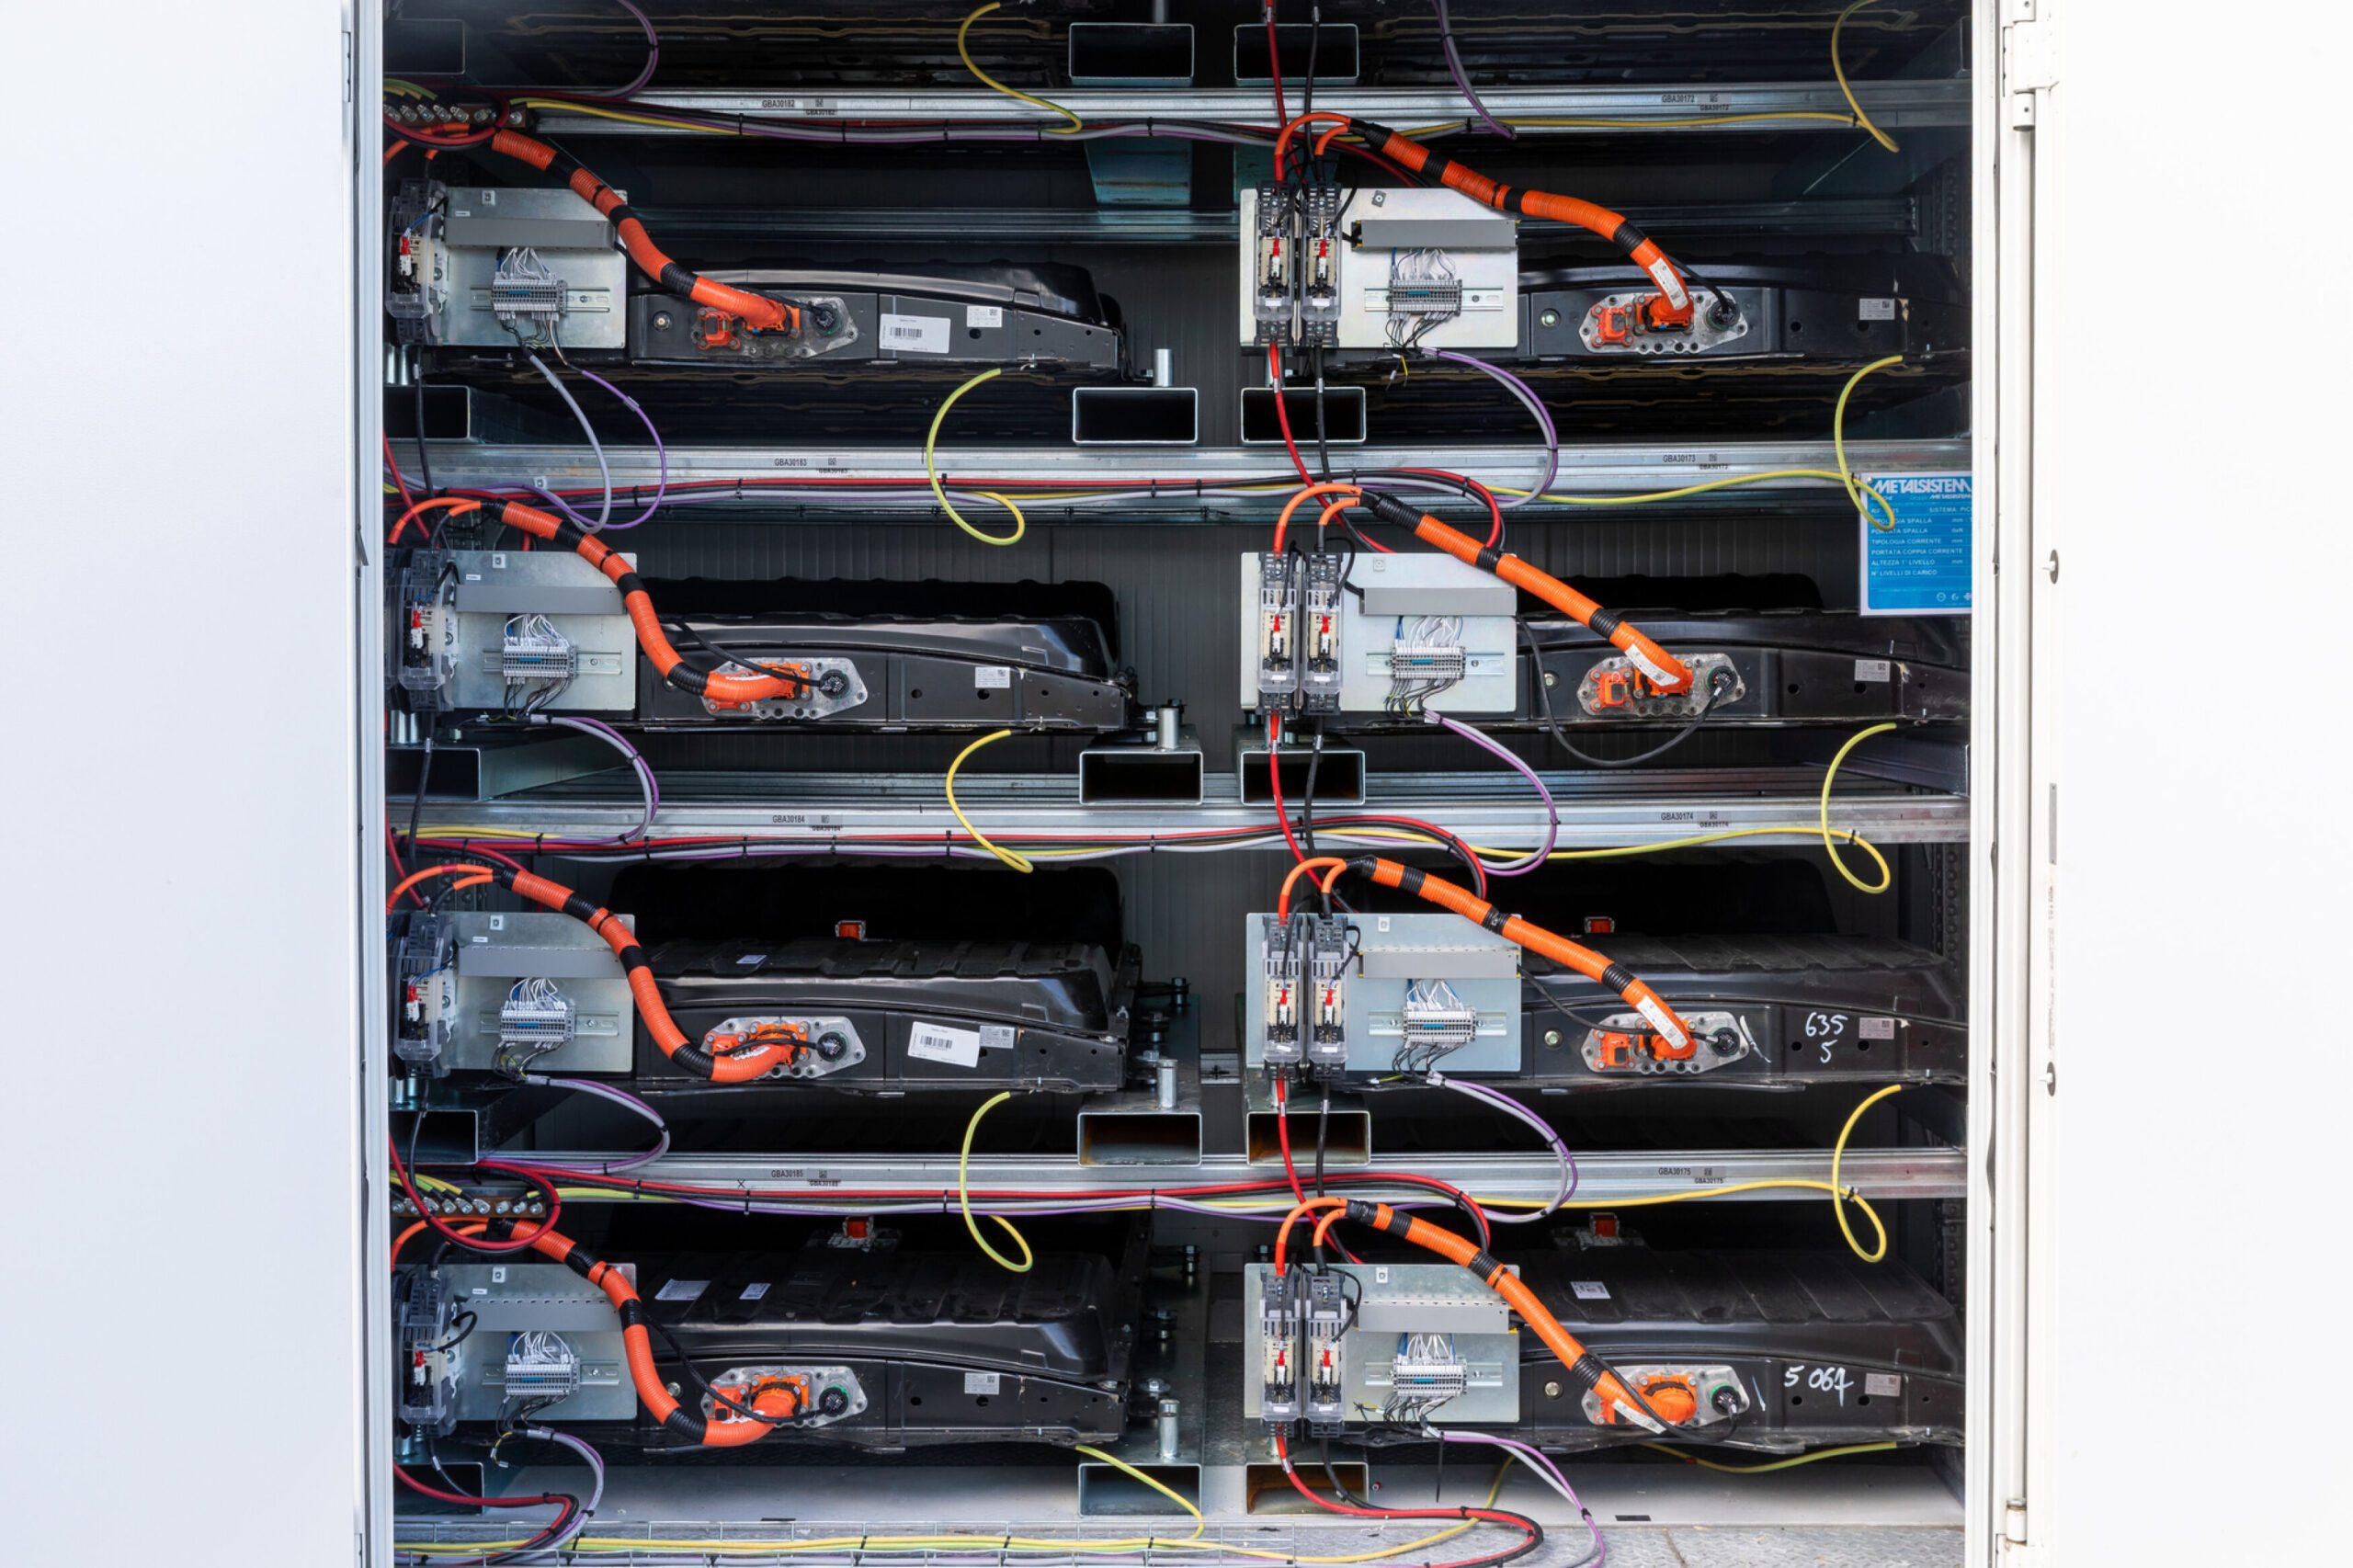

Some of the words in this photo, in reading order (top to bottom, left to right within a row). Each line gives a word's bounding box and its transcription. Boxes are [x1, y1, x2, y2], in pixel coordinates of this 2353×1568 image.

[1662, 94, 1696, 103] GBA30172
[761, 99, 795, 108] GBA30182
[774, 458, 807, 467] GBA30183
[1662, 454, 1696, 462] GBA30173
[1873, 478, 1972, 494] METALSISTEM
[772, 814, 805, 824] GBA30184
[1661, 812, 1694, 821] GBA30174
[1805, 1012, 1848, 1037] 635
[1820, 1039, 1838, 1063] 5
[770, 1169, 803, 1177] GBA30185
[1658, 1167, 1691, 1176] GBA30175
